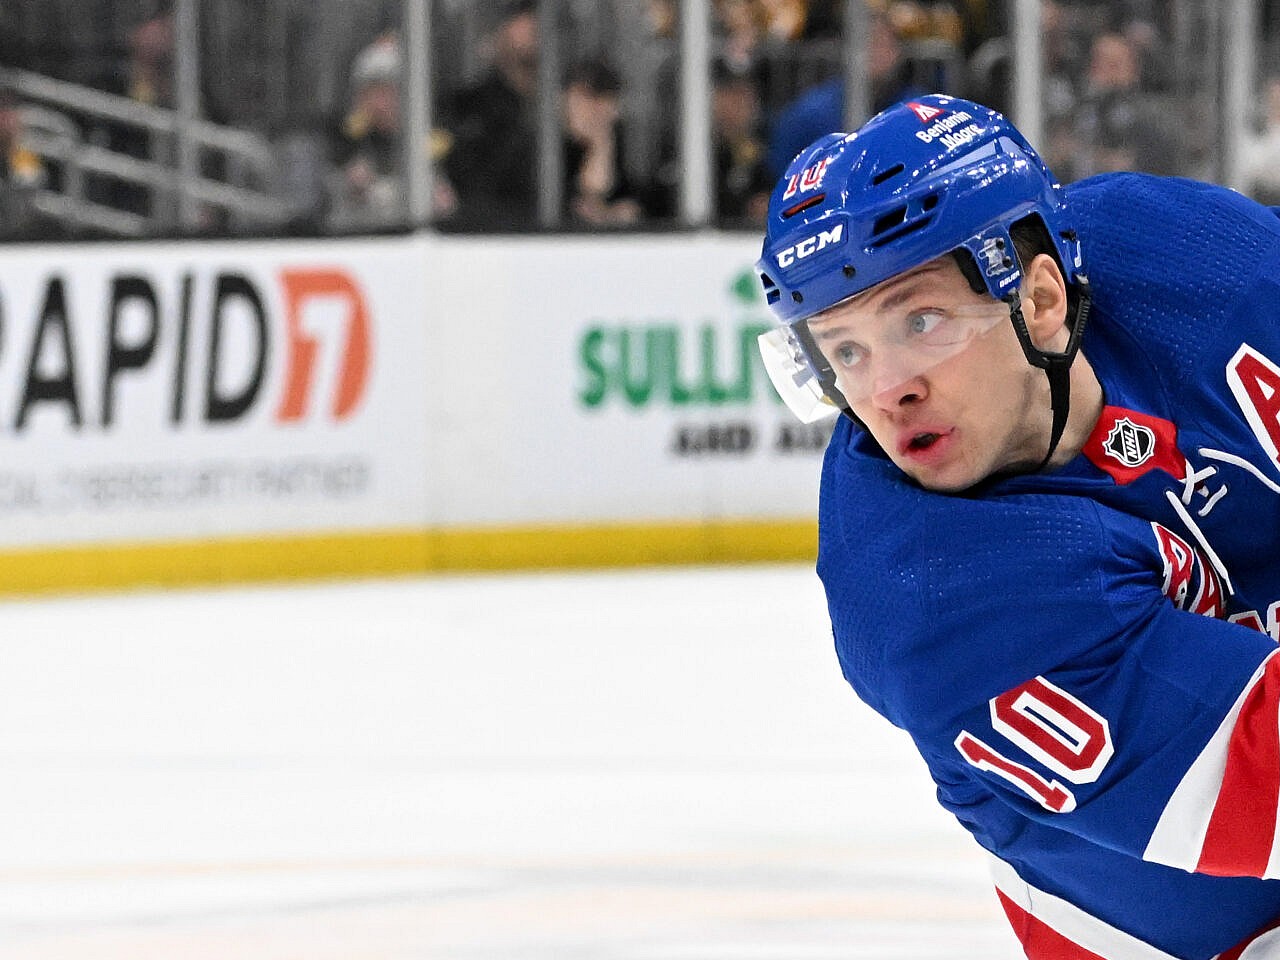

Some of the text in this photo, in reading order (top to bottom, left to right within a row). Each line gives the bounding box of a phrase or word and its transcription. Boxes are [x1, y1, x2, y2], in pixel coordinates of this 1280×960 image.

[915, 109, 973, 144] Benjamin
[938, 123, 986, 152] Moore
[776, 223, 843, 269] CCM
[1123, 429, 1138, 459] NHL
[953, 675, 1115, 814] 10
